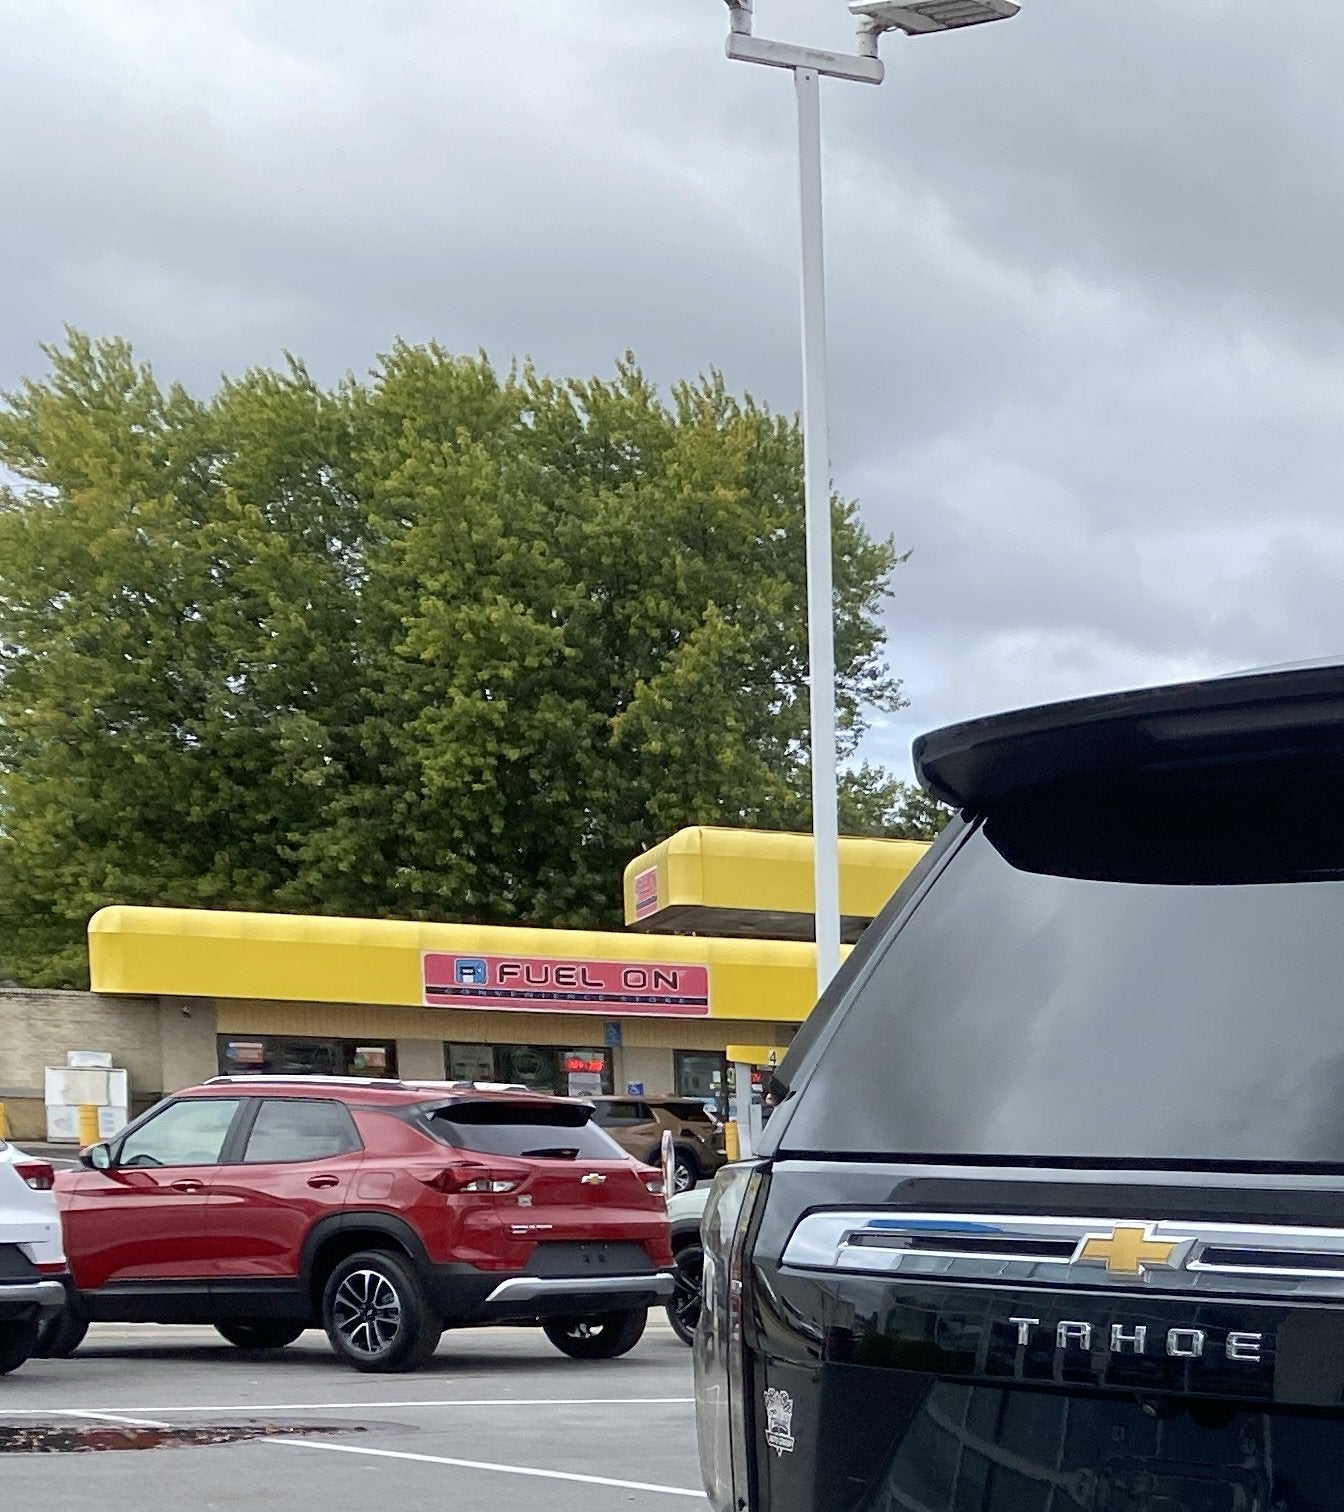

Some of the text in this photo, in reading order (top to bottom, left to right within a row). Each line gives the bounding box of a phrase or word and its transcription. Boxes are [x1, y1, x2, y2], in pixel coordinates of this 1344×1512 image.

[497, 962, 680, 991] FUEL ON
[1008, 1315, 1264, 1364] TAHOE
